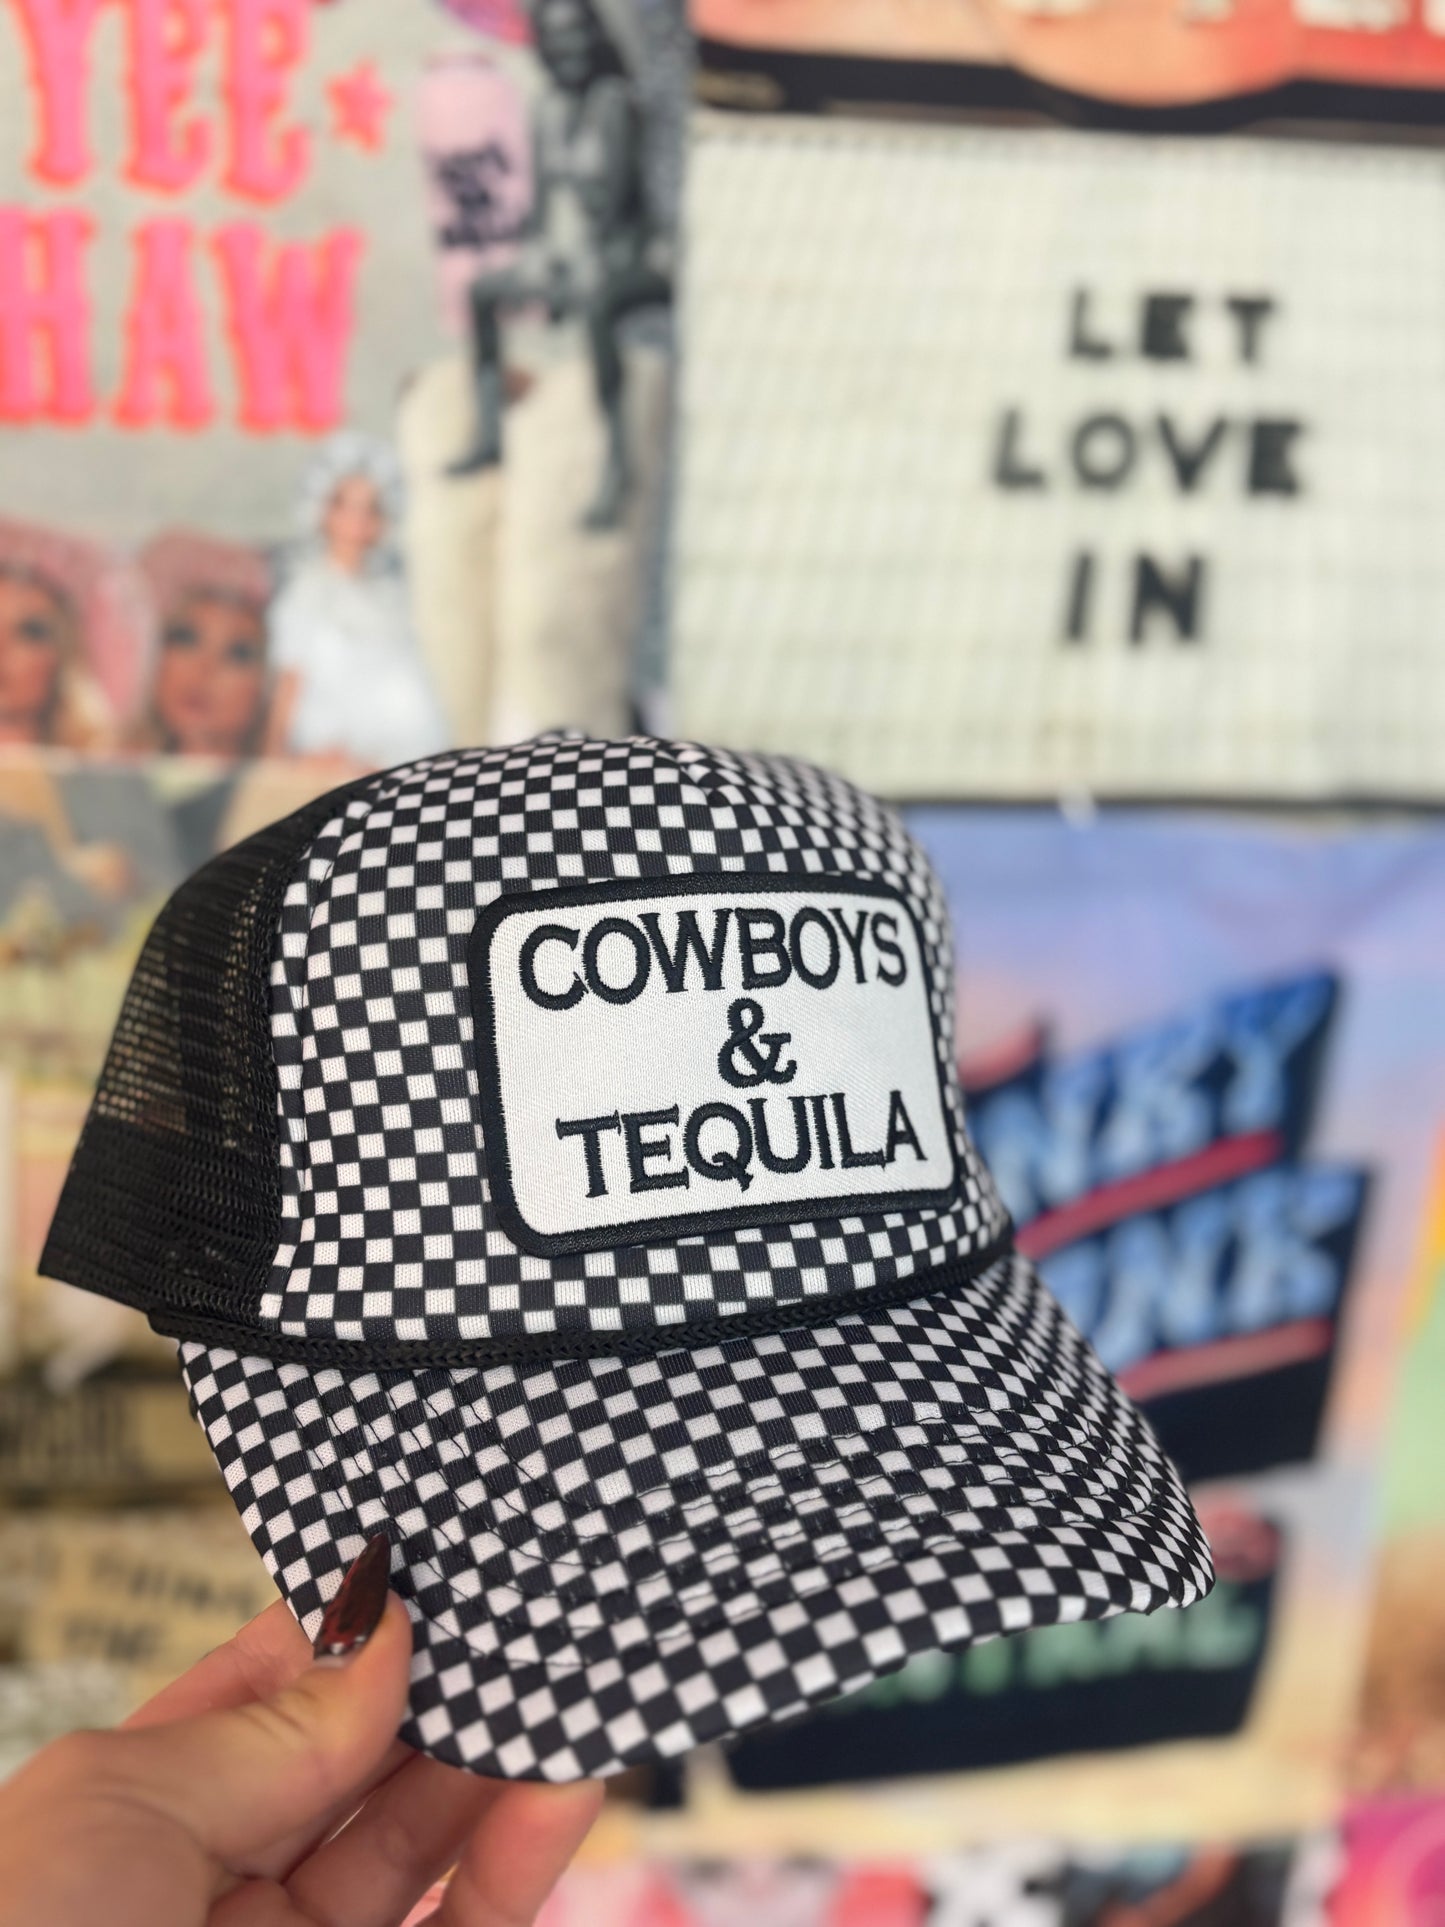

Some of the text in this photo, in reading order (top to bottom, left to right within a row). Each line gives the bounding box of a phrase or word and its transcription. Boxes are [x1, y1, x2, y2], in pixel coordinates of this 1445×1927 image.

[10, 0, 312, 205] YEE
[0, 207, 363, 436] HAW
[1069, 288, 1274, 362] LET
[991, 408, 1308, 497] LOVE
[1063, 550, 1206, 644] IN
[518, 906, 907, 1011] COWBOYS
[717, 998, 797, 1088] &
[555, 1090, 928, 1198] TEQUILA
